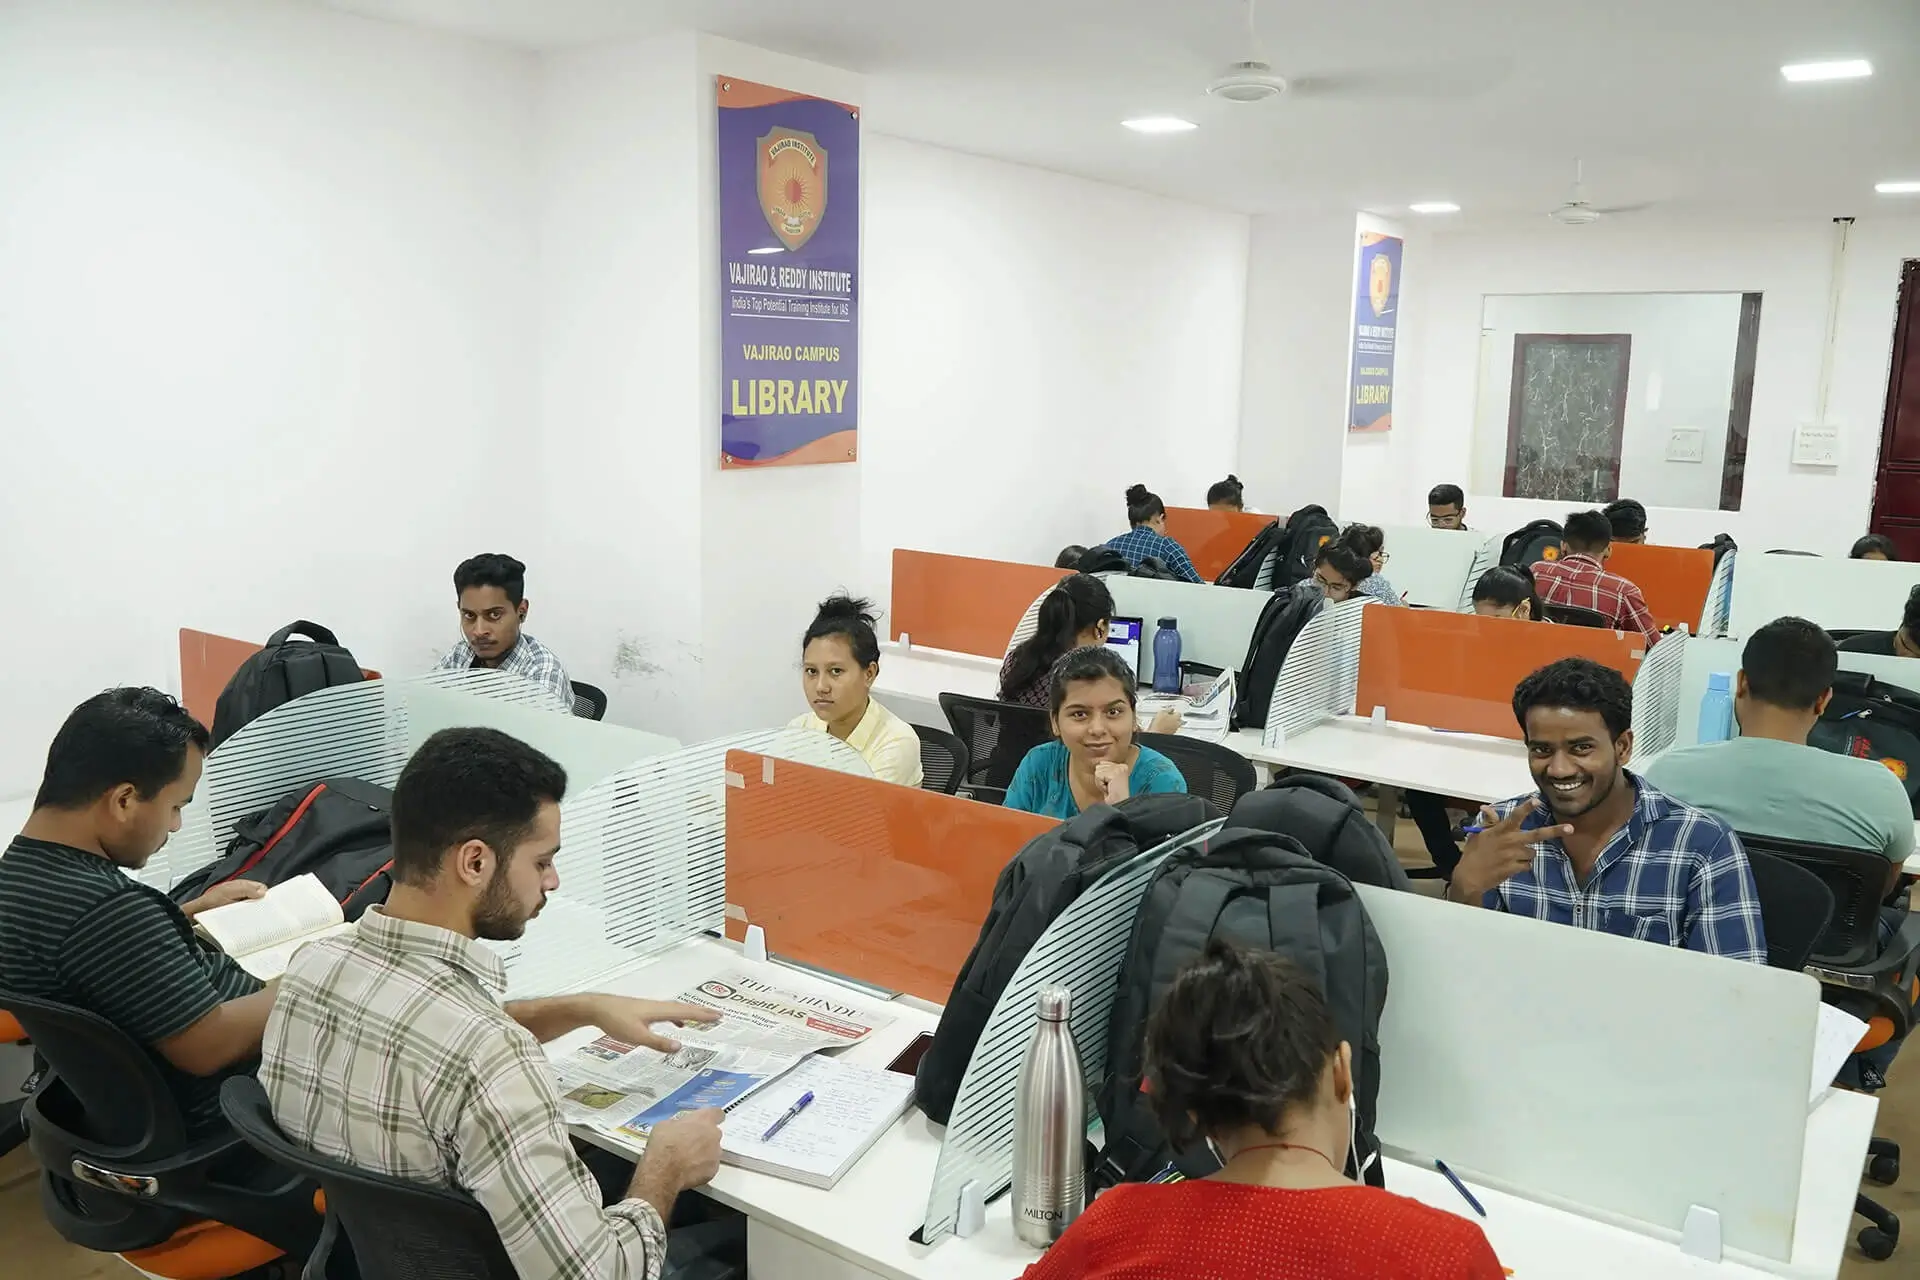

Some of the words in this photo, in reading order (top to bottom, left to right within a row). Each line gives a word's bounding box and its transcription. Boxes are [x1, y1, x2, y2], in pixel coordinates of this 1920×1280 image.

[729, 262, 768, 286] VAJIRAO
[770, 266, 777, 287] &
[779, 267, 807, 289] REDDY
[809, 269, 852, 292] INSTITUTE
[732, 295, 751, 310] India's
[751, 296, 762, 313] Top
[763, 298, 787, 312] Potential
[788, 299, 809, 316] Training
[809, 300, 831, 314] Institute
[831, 302, 839, 314] for
[839, 303, 849, 315] IAS
[743, 343, 792, 361] VAJIRAO
[795, 346, 840, 362] CAMPUS
[732, 379, 848, 416] LIBRARY
[1356, 383, 1390, 405] LIBRARY
[729, 994, 780, 1010] Drishti
[778, 1007, 808, 1019] IAS
[740, 976, 776, 993] THE
[799, 995, 865, 1018] HINDU
[1024, 1207, 1063, 1221] MILTON
